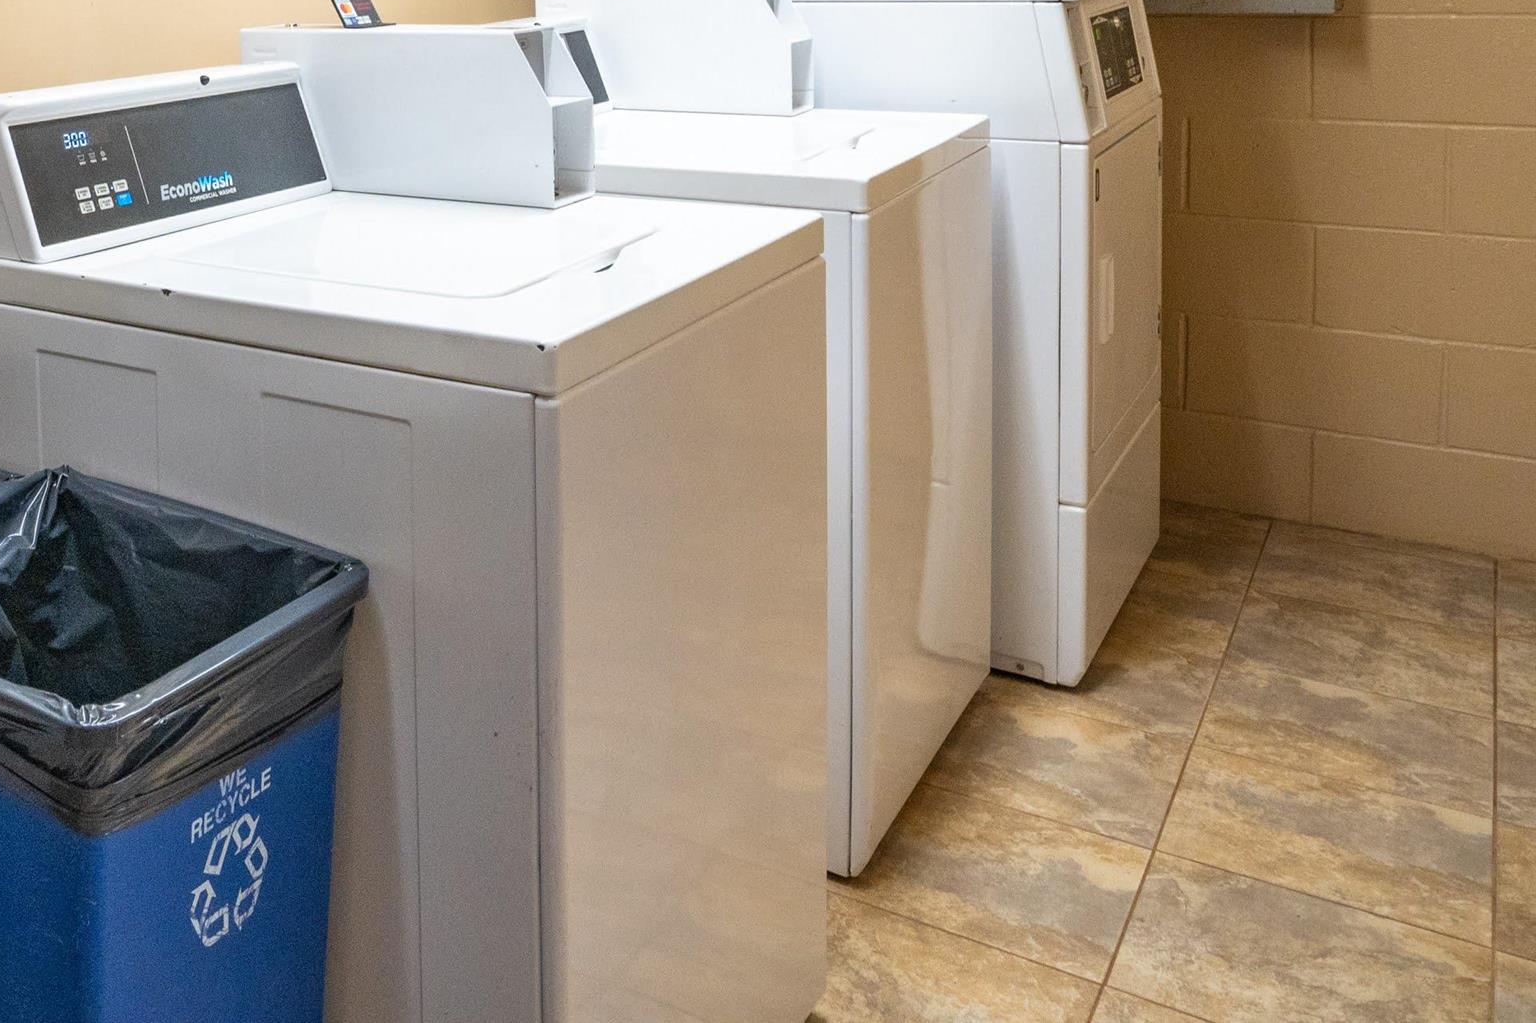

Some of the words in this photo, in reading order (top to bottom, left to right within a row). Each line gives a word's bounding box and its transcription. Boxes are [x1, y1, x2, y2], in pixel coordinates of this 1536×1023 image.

[160, 171, 234, 201] EconoWash
[189, 191, 218, 203] COMMERCIAL
[218, 187, 237, 196] WASHER
[219, 768, 247, 797] WE
[191, 766, 272, 844] RECYCLE
